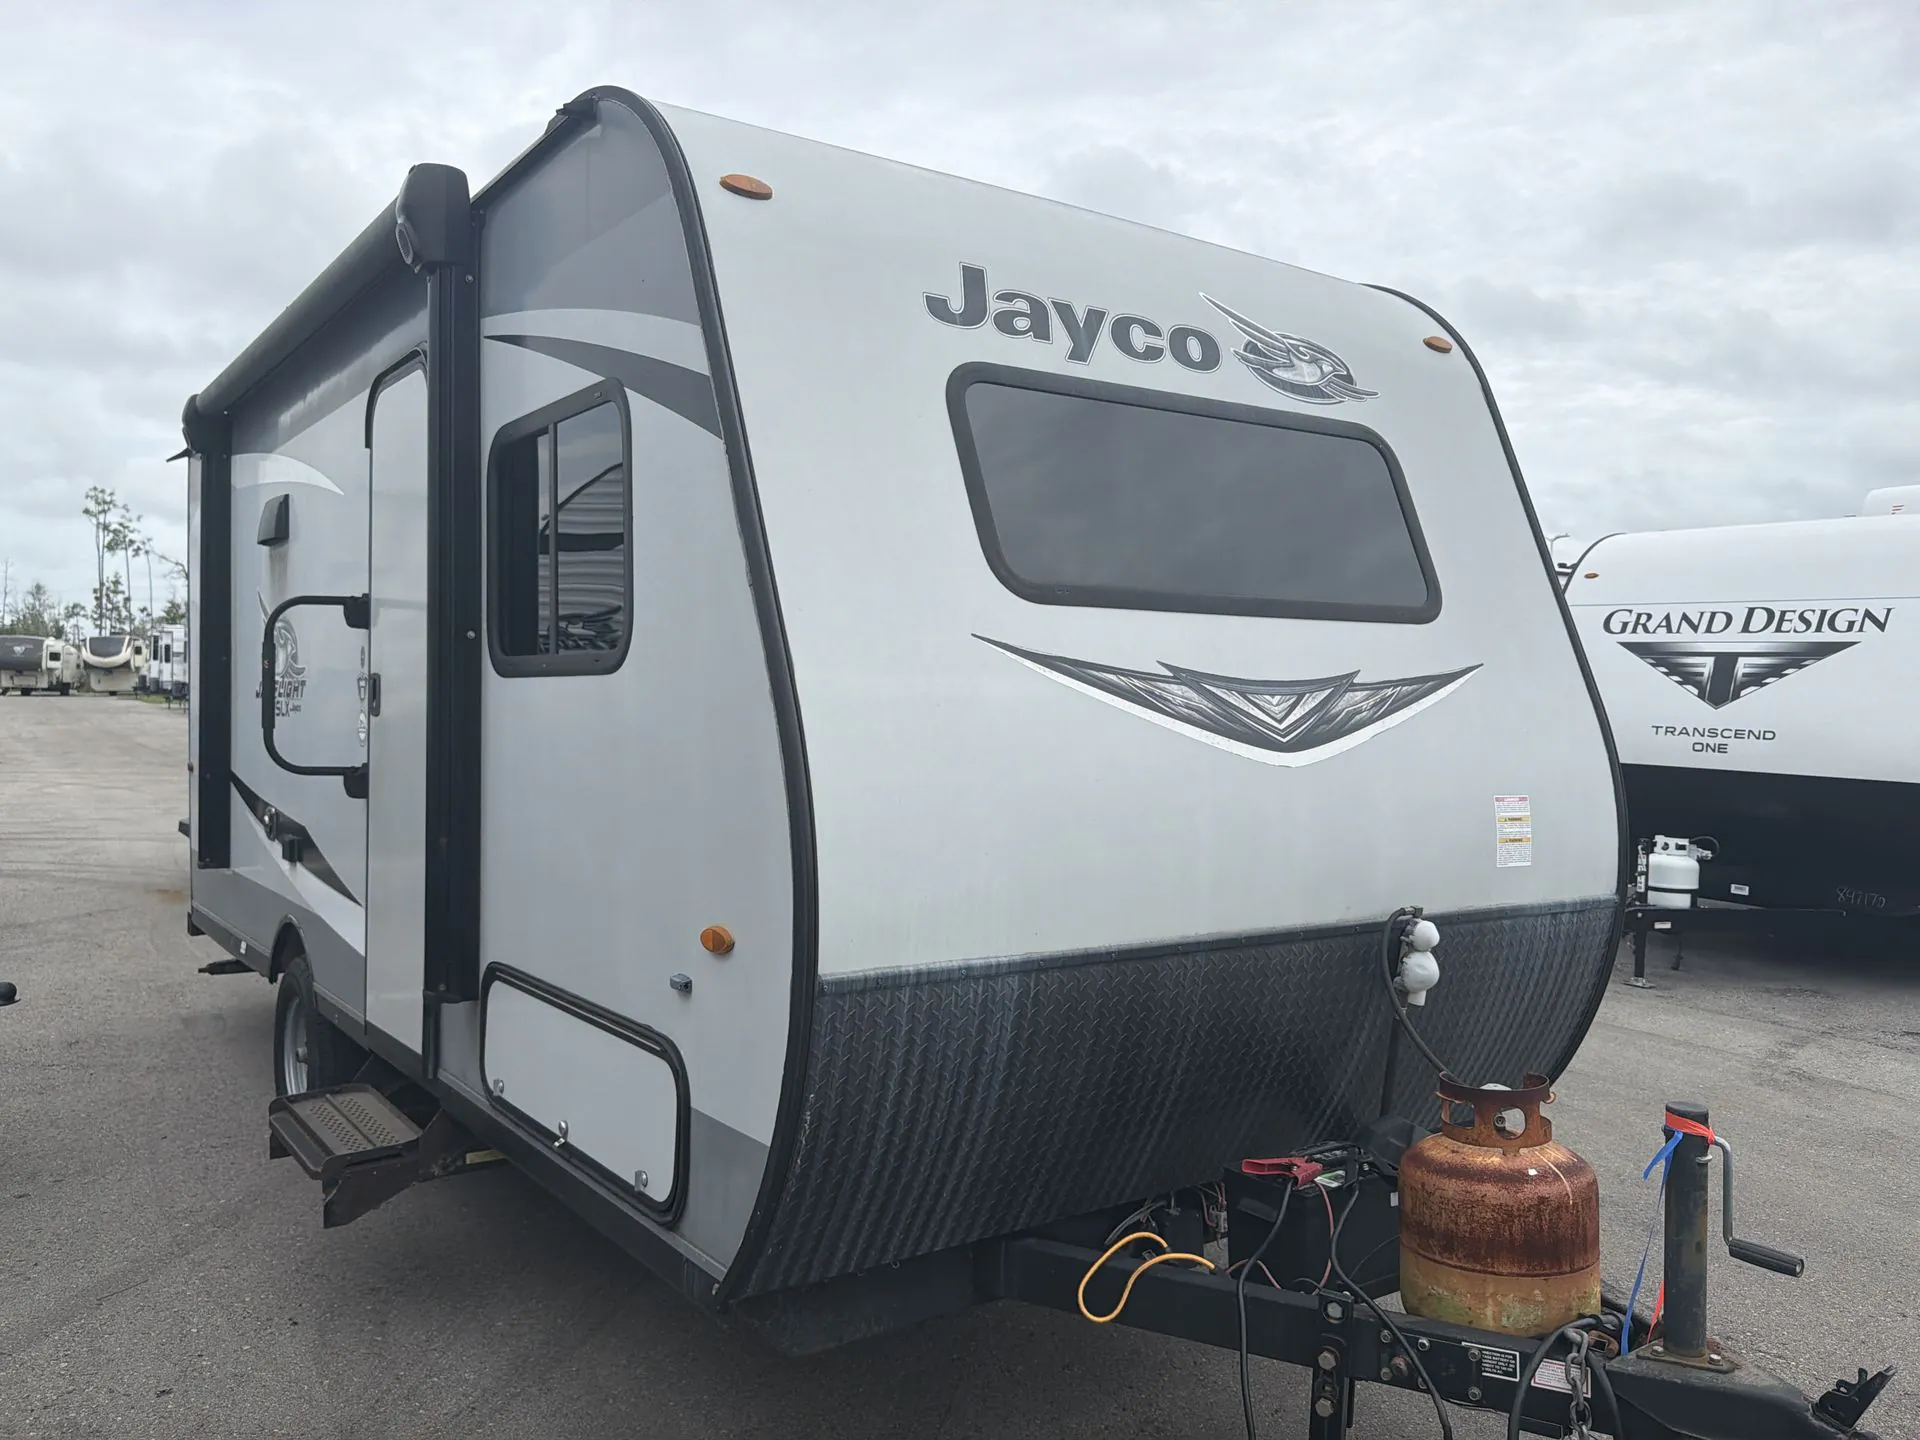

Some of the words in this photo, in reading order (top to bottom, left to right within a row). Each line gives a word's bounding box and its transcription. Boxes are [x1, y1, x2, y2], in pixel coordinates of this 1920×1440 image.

[922, 260, 1224, 375] Jayco
[1603, 608, 1733, 635] GRAND
[1737, 606, 1895, 634] DESIGN
[1651, 725, 1776, 741] TRANSCEND
[1692, 742, 1728, 754] ONE
